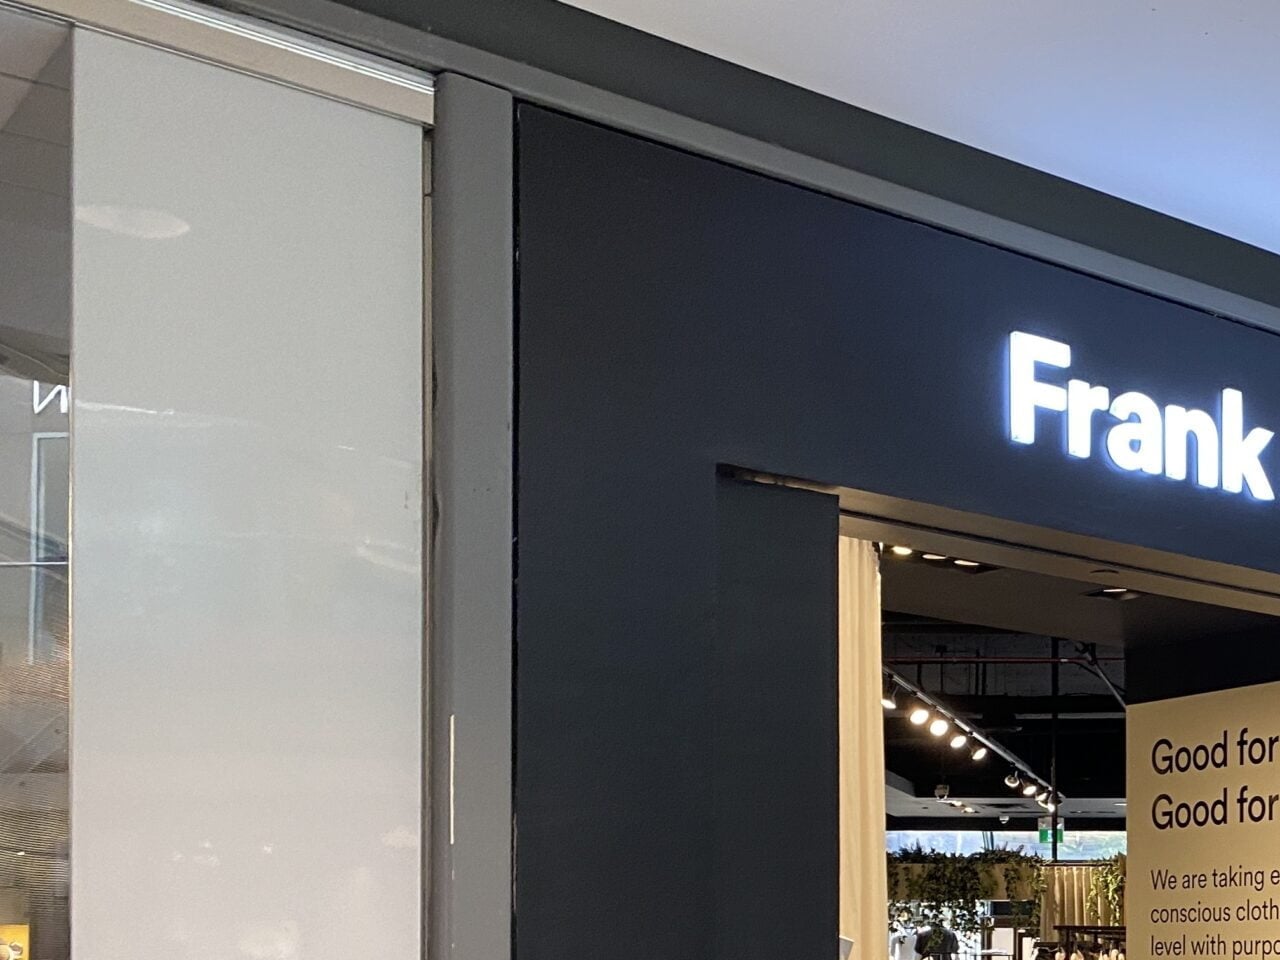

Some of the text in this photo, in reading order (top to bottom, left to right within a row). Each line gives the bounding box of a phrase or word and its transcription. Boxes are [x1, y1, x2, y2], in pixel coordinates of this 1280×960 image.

[1009, 331, 1275, 500] Frank
[1151, 730, 1228, 775] Good
[1237, 728, 1279, 765] for
[1151, 787, 1228, 830] Good
[1236, 786, 1279, 823] for
[1151, 869, 1177, 890] We
[1182, 872, 1207, 889] are
[1212, 865, 1264, 891] taking
[1151, 901, 1231, 923] conscious
[1151, 934, 1186, 956] level
[1191, 934, 1226, 955] with
